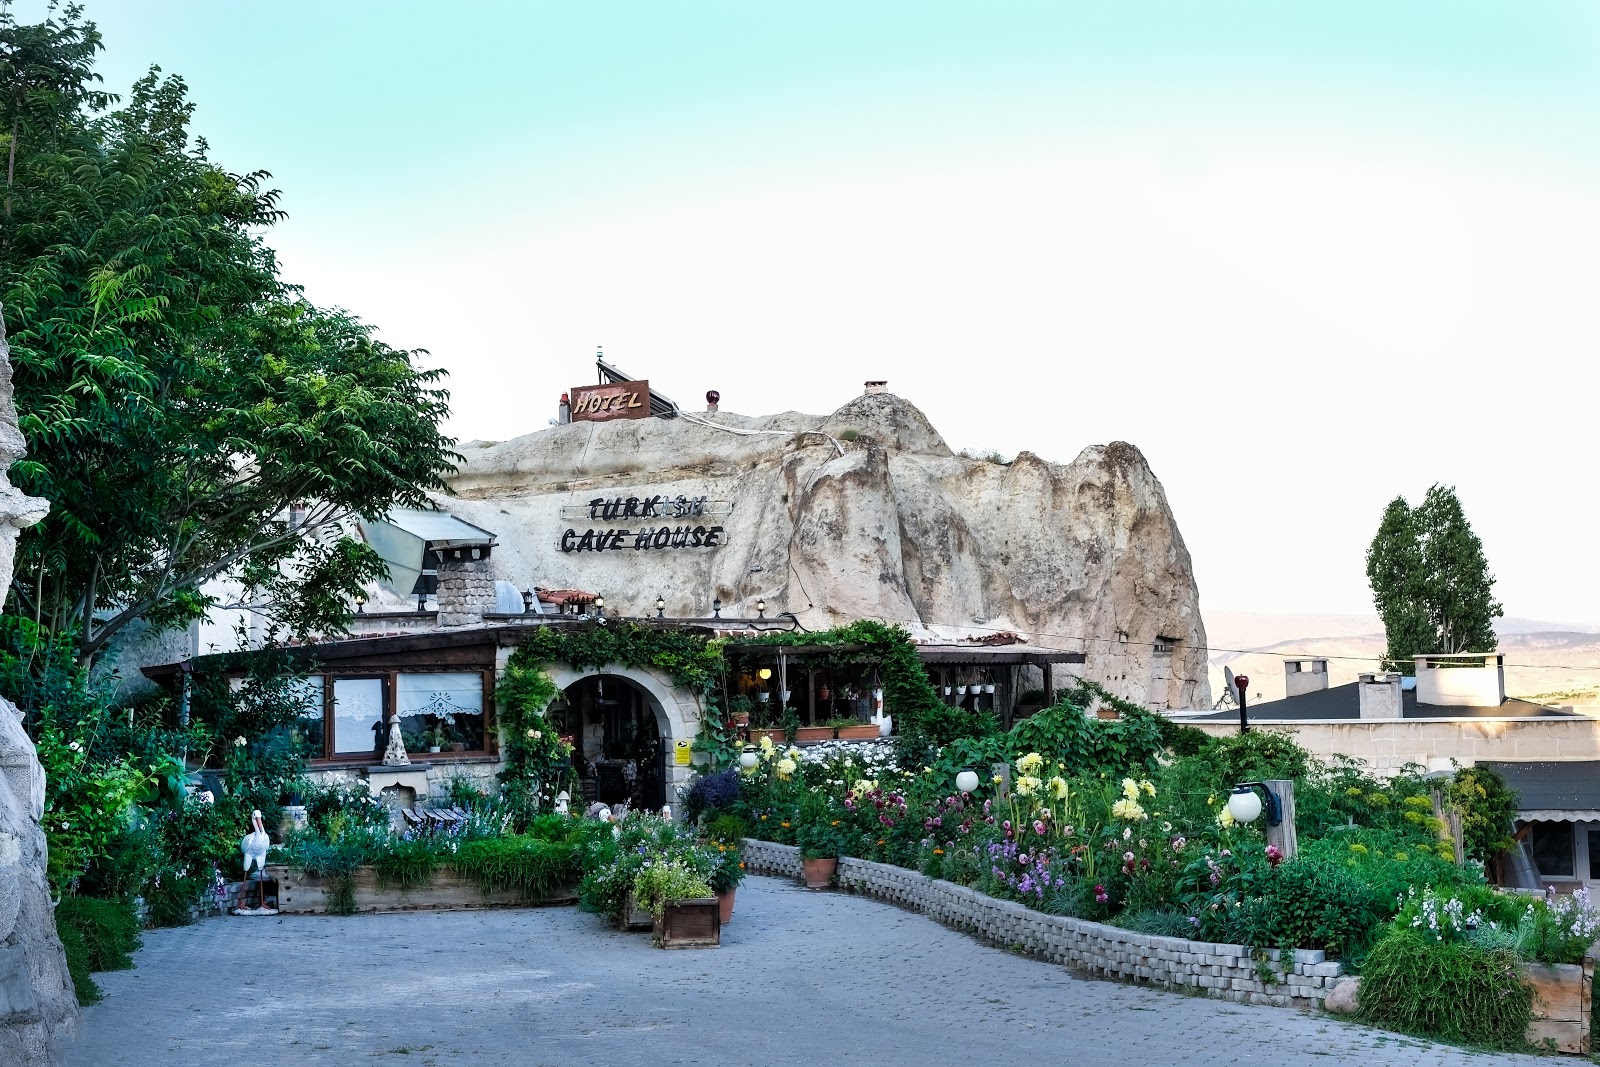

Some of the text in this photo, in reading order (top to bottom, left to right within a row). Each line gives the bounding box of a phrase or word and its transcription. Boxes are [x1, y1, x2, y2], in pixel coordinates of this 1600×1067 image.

[574, 391, 643, 414] HOTEL
[588, 495, 707, 521] TURKISH
[561, 525, 724, 552] CAVE HOUSE
